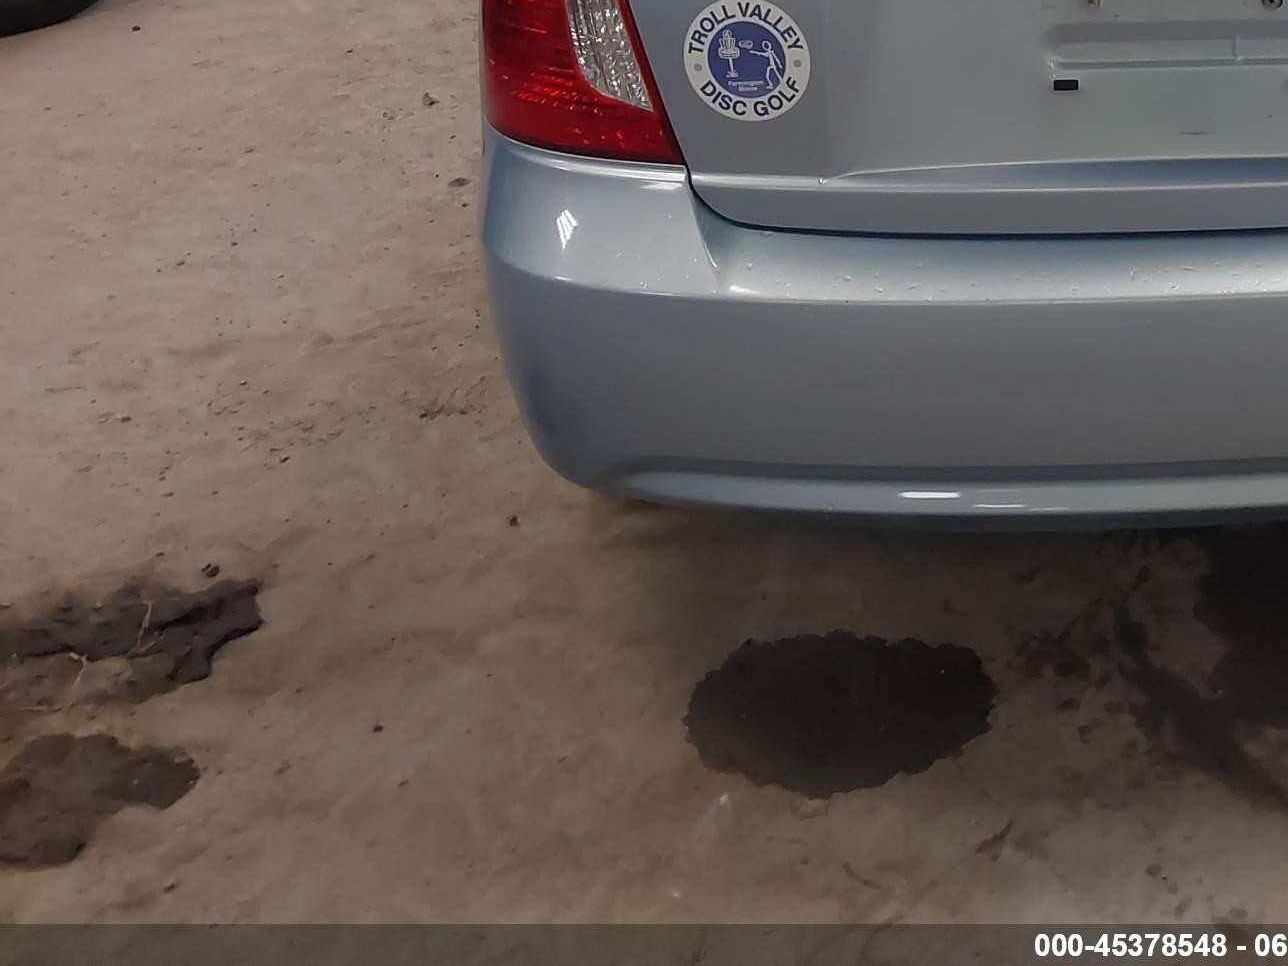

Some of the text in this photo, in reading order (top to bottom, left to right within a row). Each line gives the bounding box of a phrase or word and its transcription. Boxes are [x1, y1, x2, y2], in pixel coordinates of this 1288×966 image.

[688, 2, 804, 54] TROLL VALLEY
[700, 76, 800, 116] DISC GOLF
